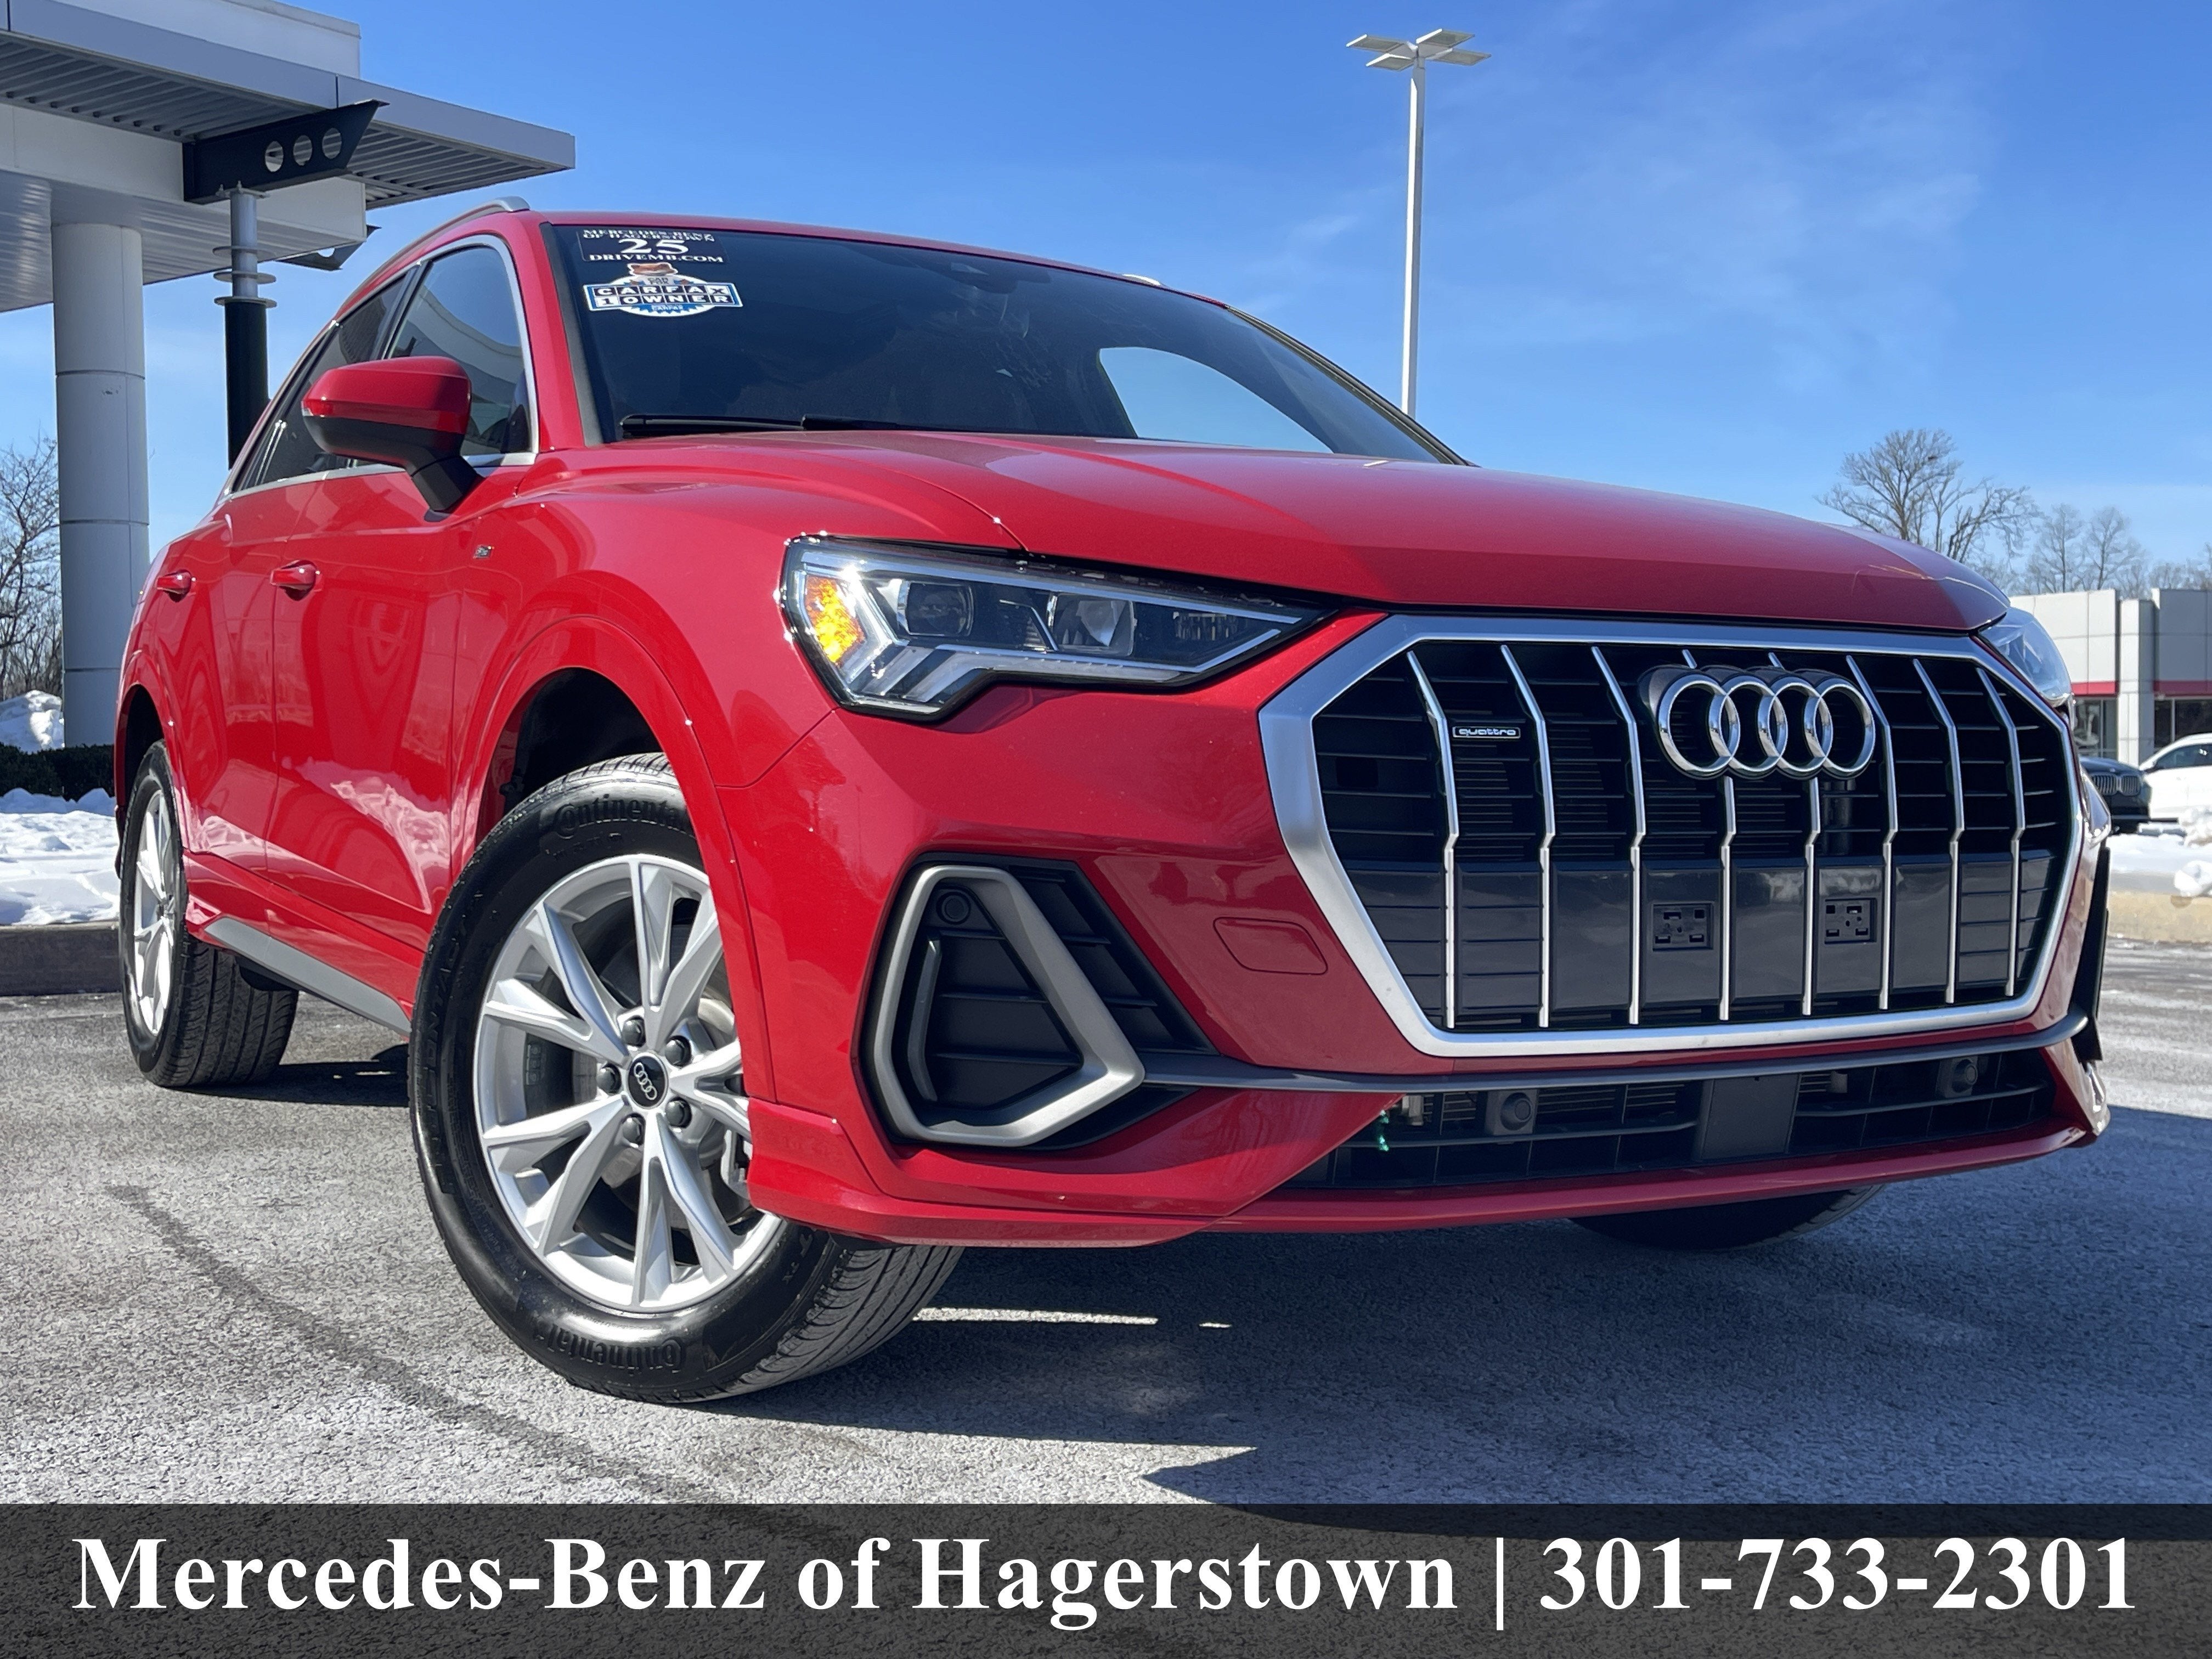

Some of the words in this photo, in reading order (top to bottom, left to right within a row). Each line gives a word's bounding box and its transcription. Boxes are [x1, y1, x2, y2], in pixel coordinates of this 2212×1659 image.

[618, 238, 689, 254] 25
[589, 253, 724, 263] DRIVEMB.COM
[597, 286, 726, 295] CARFAX
[622, 296, 729, 305] OWNER
[1458, 727, 1516, 737] quattro
